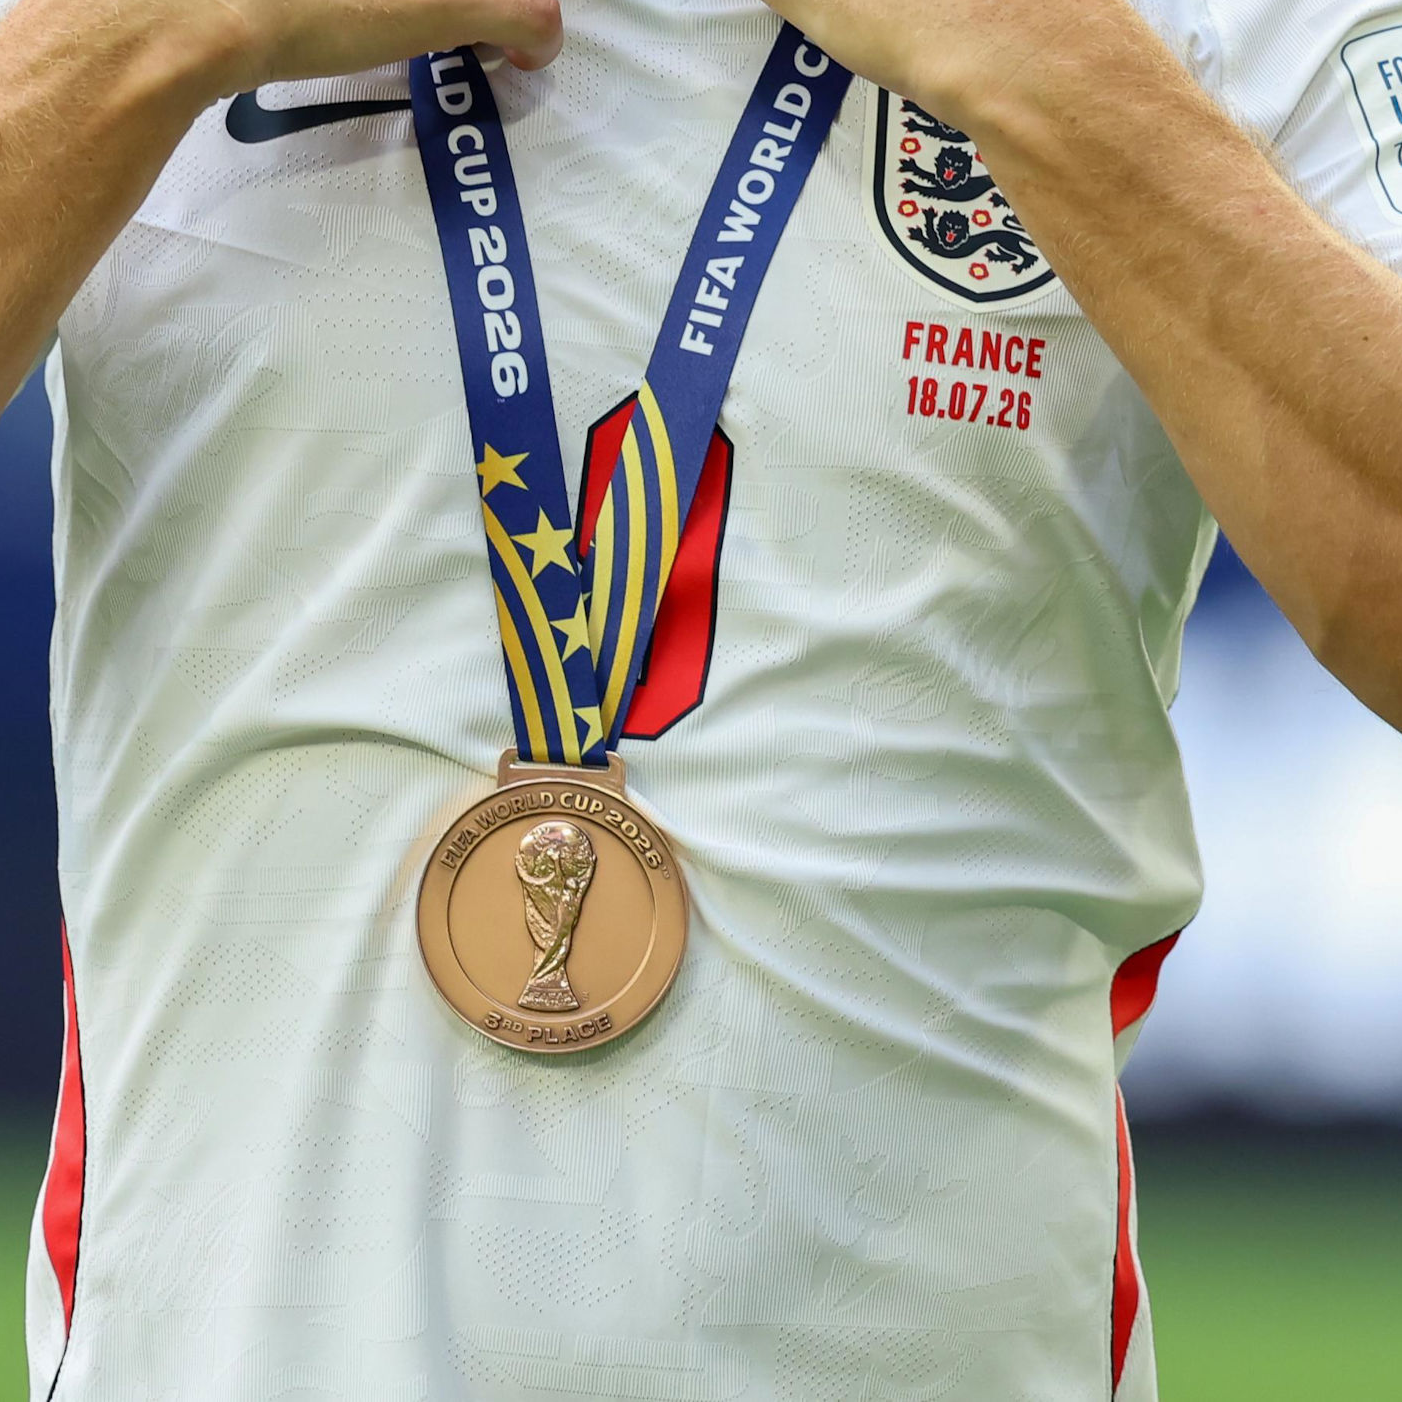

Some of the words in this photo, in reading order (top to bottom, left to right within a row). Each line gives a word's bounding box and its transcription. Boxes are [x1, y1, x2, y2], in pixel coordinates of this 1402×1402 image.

[447, 124, 498, 218] CUP
[679, 256, 746, 356] FIFA
[716, 83, 812, 242] WORLD
[467, 225, 529, 398] 2026
[901, 320, 1047, 380] FRANCE
[906, 375, 1032, 432] 18.07.26
[440, 826, 481, 870] FIFA
[474, 791, 555, 831] WORLD
[559, 791, 605, 815] CUP
[604, 809, 664, 870] 2026
[526, 1013, 613, 1045] PLACE
